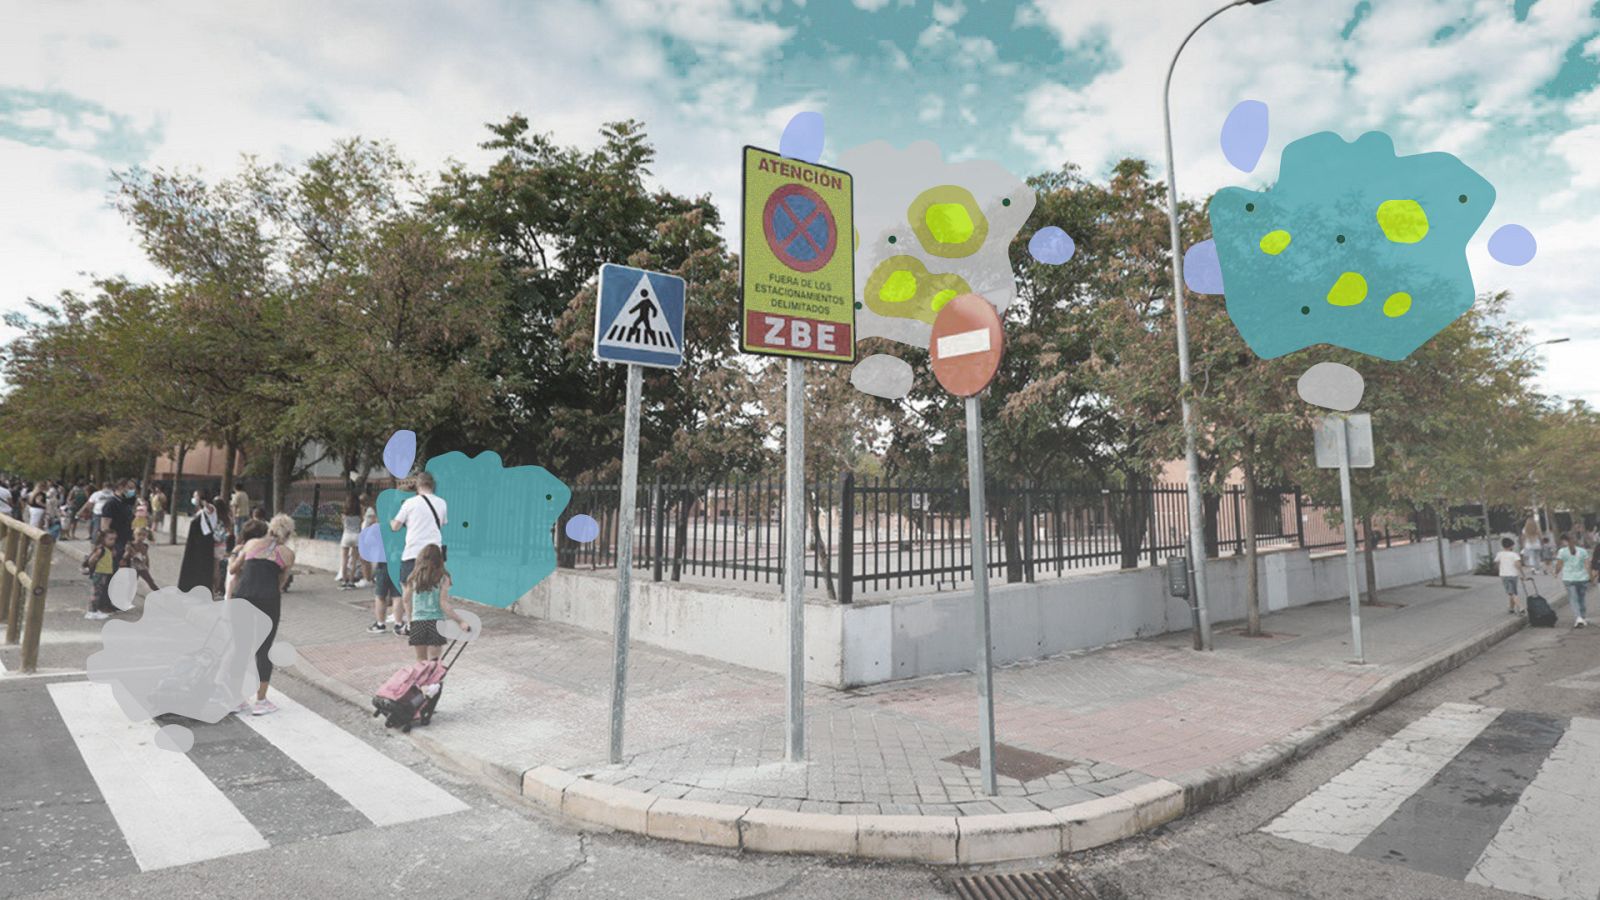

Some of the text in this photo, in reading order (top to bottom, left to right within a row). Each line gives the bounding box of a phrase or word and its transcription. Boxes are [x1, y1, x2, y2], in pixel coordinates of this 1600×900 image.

[758, 158, 842, 190] ATENCIÓN
[769, 273, 832, 291] FUERA DE LOS
[755, 283, 845, 305] ESTACIONAMIENTOS
[771, 298, 830, 315] DELIMITADOS
[764, 316, 836, 351] ZBE
